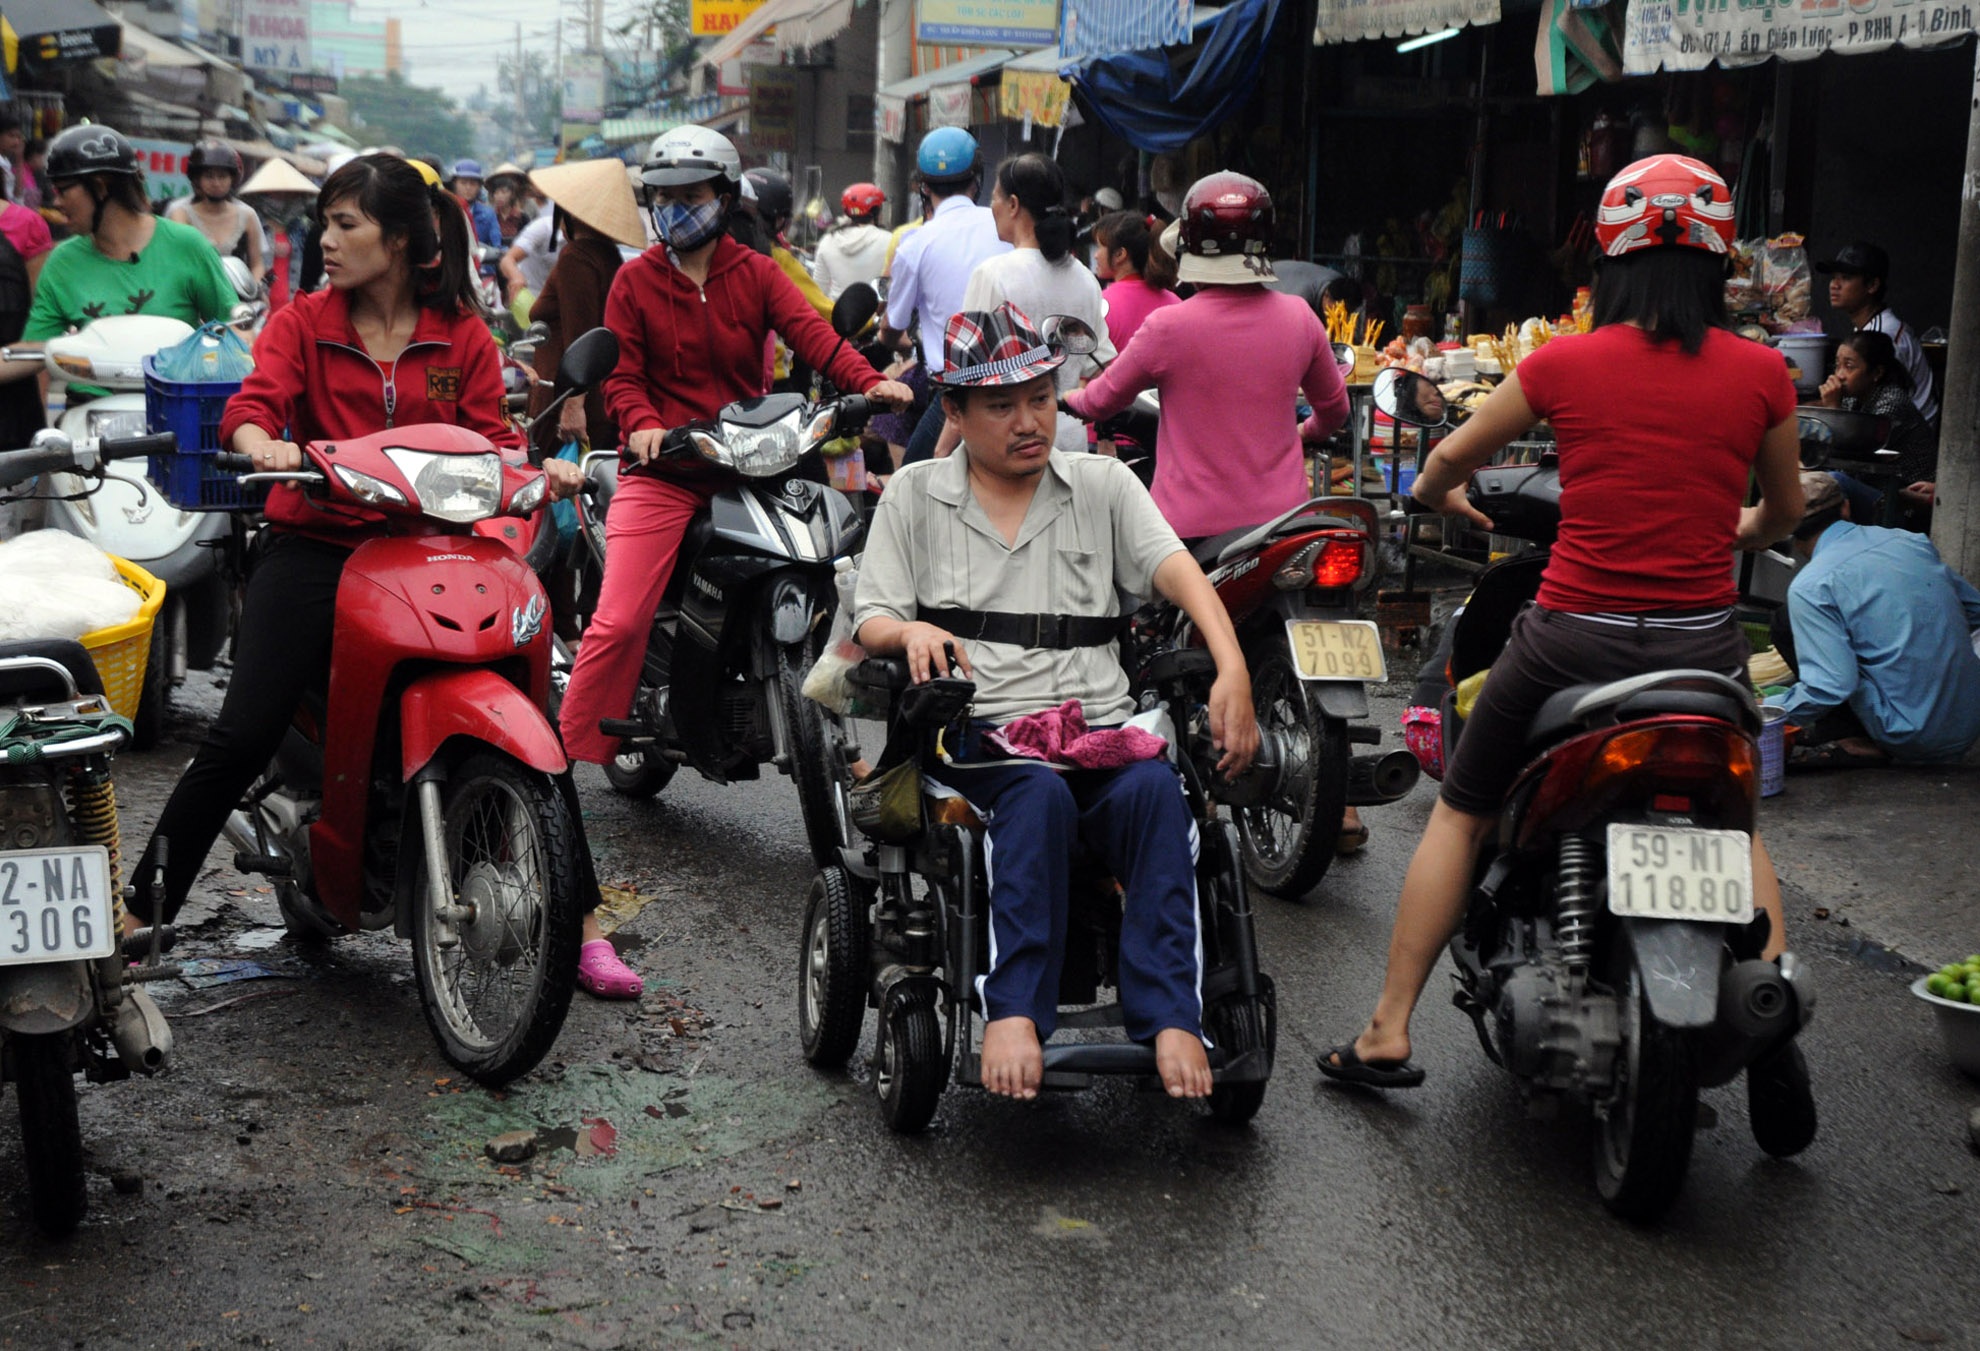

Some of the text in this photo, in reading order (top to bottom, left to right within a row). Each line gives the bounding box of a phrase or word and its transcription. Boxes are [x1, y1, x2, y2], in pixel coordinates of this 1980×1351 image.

[427, 553, 476, 562] HONDA
[693, 572, 724, 601] YAMAHA
[1301, 624, 1368, 649] 51-N2
[1306, 650, 1372, 676] 7099
[1631, 832, 1723, 873] 59-N1
[0, 856, 90, 905] 2-NA
[1619, 872, 1742, 914] 118.80
[9, 905, 94, 953] 306
